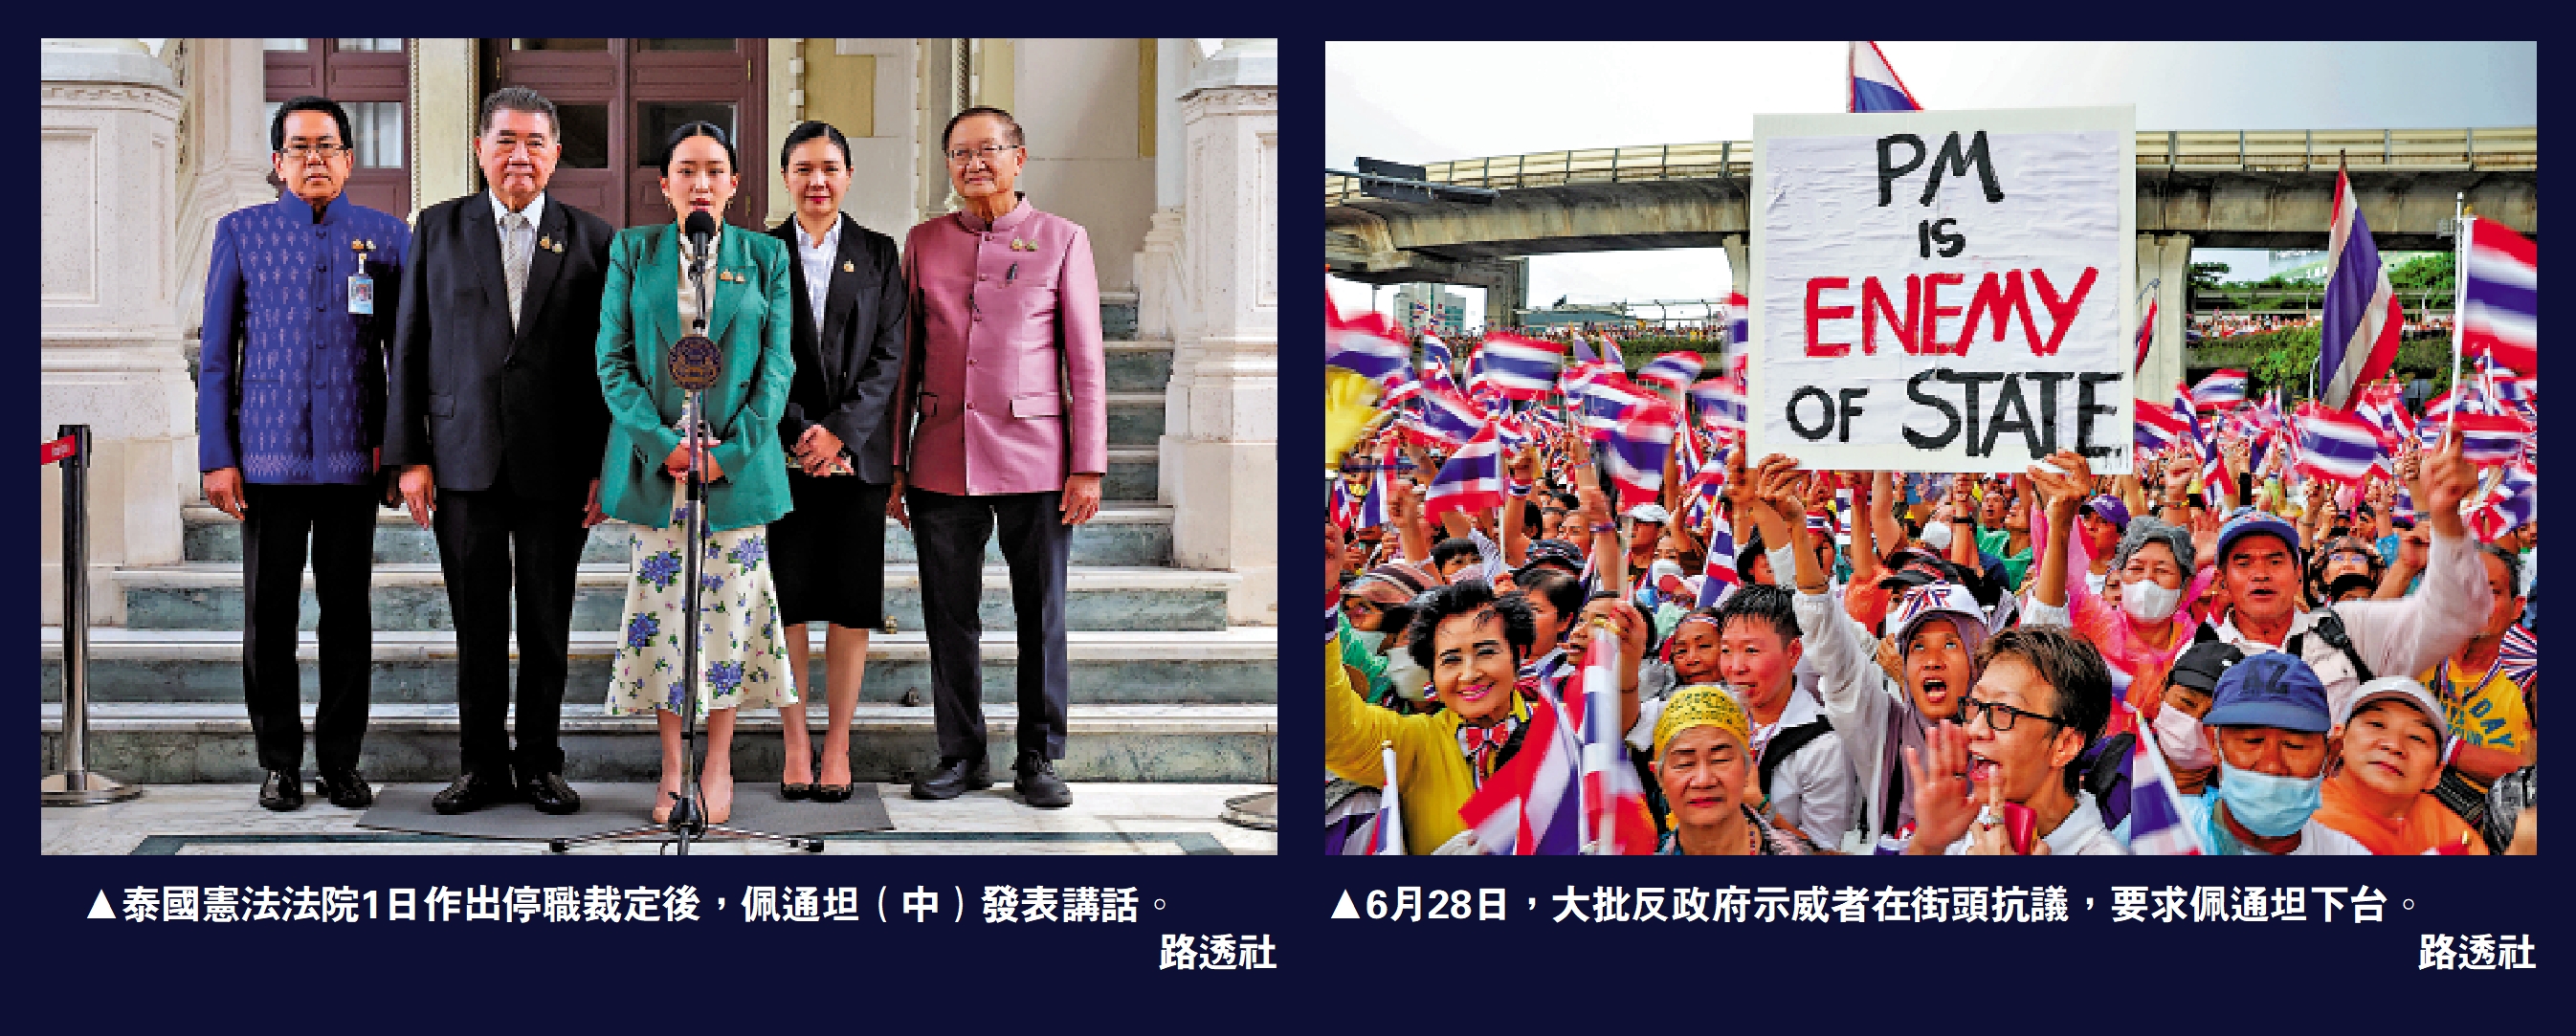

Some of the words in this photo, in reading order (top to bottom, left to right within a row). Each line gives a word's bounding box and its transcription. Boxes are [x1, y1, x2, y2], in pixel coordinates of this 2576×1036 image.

[1876, 130, 2005, 207] PM
[1919, 217, 1966, 259] IS
[1805, 266, 2099, 358] ENEMY
[1785, 385, 1870, 443] OF
[1902, 368, 2124, 460] STATE
